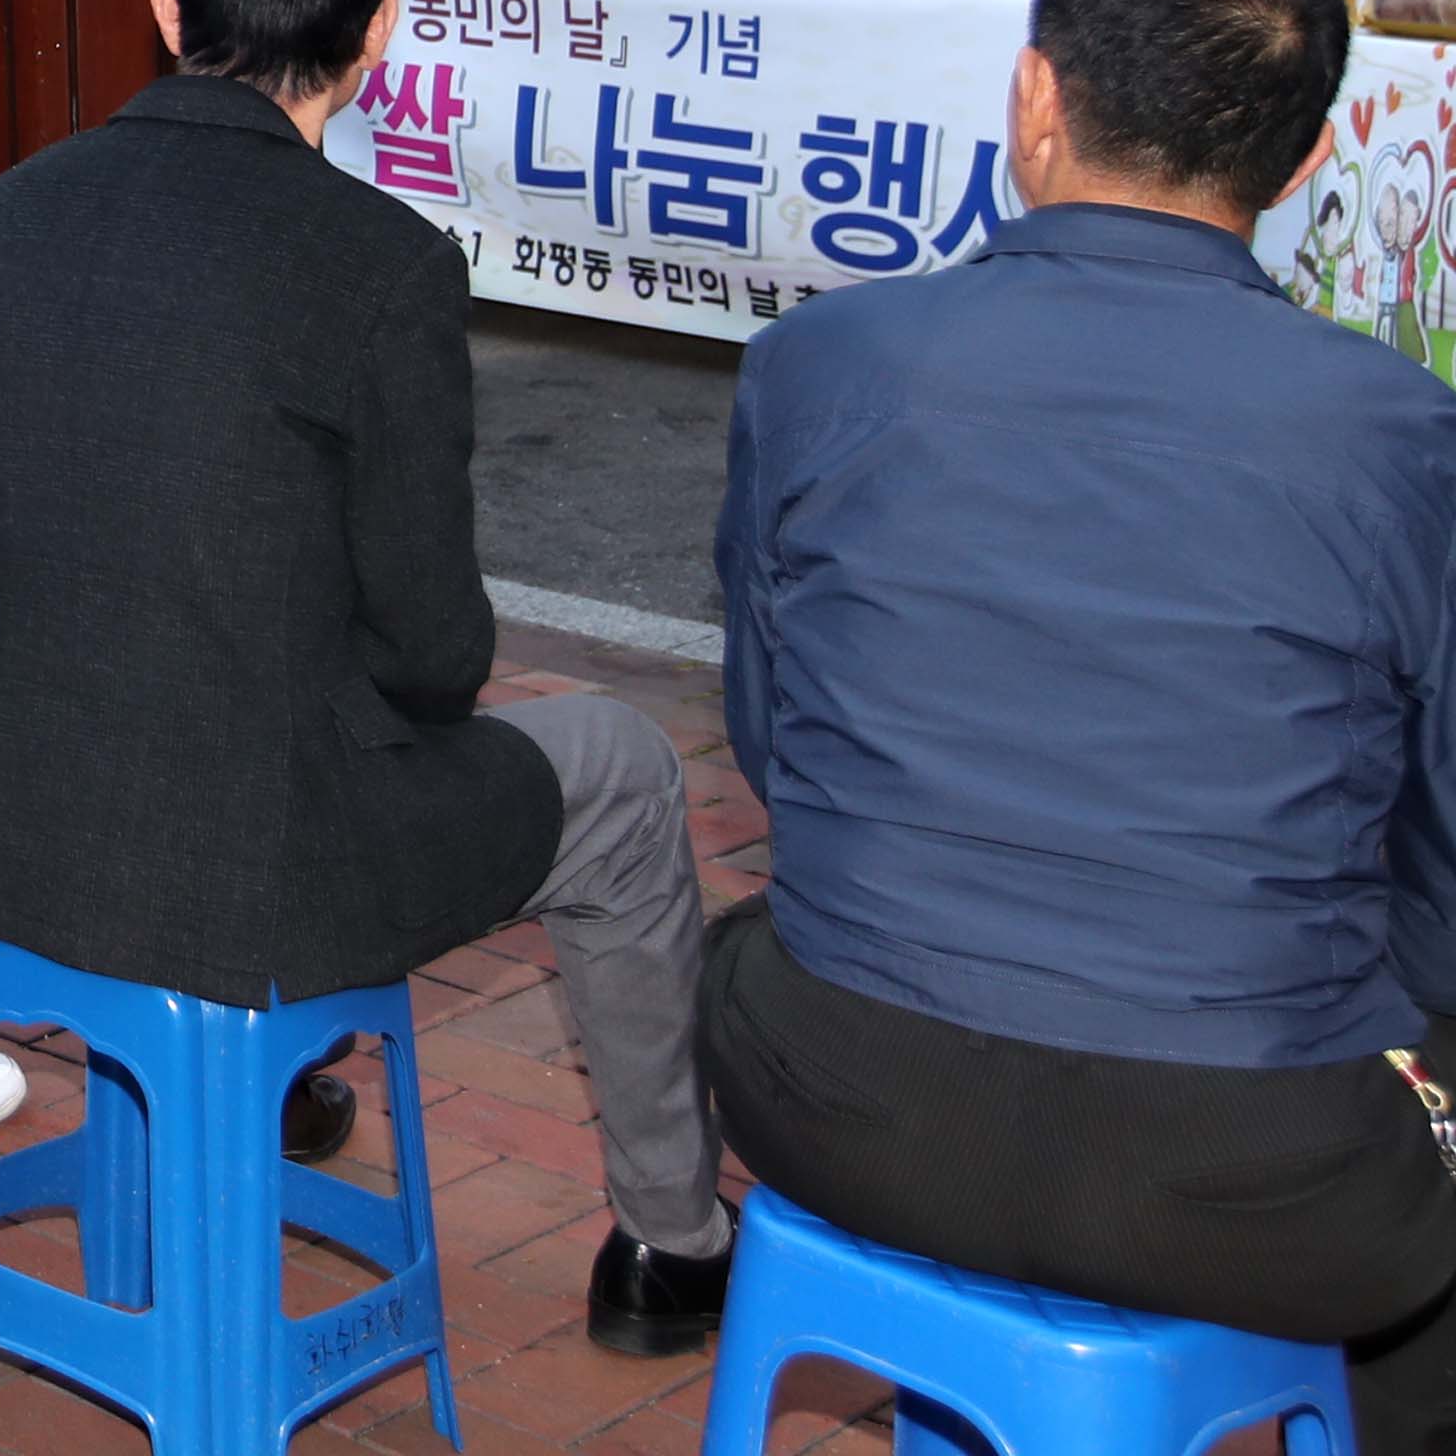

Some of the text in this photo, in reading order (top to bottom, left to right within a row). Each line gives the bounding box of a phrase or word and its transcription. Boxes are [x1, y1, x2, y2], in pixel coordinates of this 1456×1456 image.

[665, 9, 763, 82] 기념
[354, 58, 474, 202] 쌀
[512, 82, 772, 252] 나눔
[511, 234, 613, 293] 화평동
[627, 254, 732, 312] 동민의
[743, 276, 781, 320] 날
